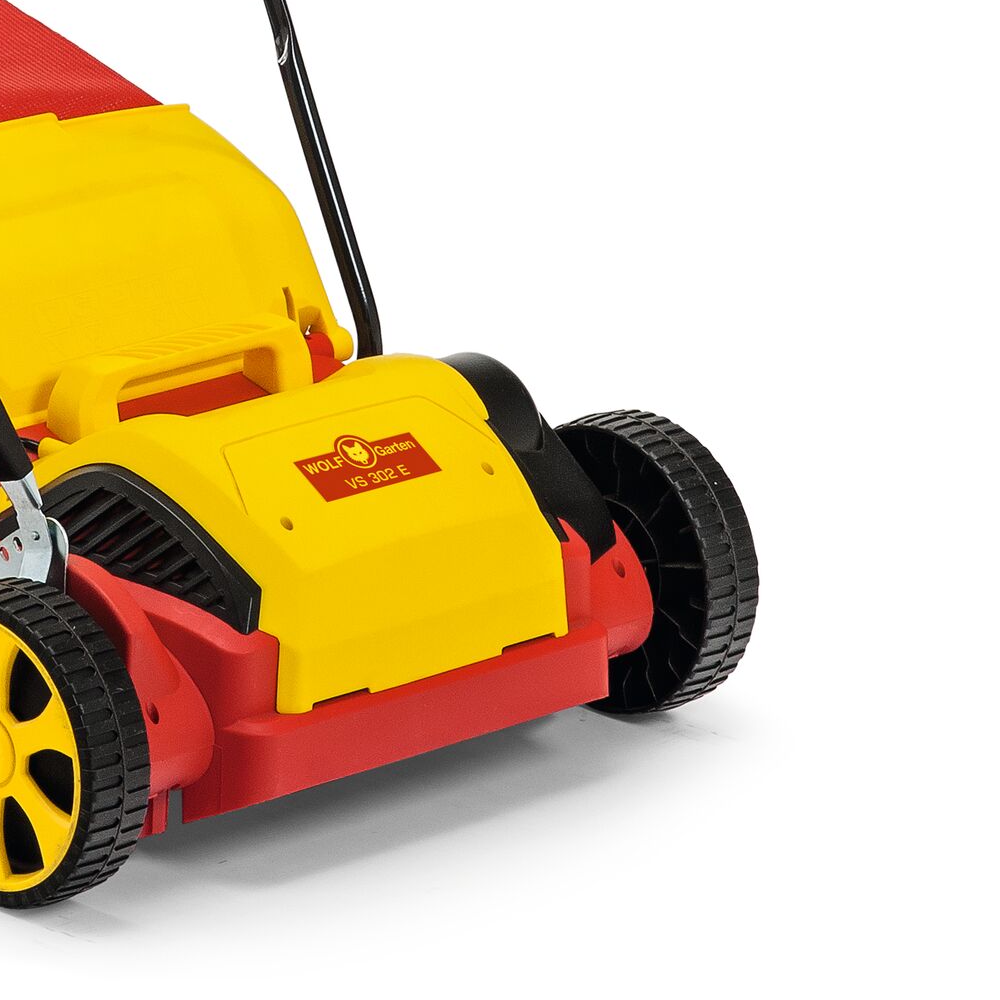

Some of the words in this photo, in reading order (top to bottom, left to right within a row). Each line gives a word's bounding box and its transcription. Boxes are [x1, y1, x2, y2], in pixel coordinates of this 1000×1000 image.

[302, 456, 345, 475] WOLF
[374, 439, 416, 456] Garten
[344, 476, 367, 489] VS
[367, 468, 398, 484] 302
[397, 464, 411, 476] E
